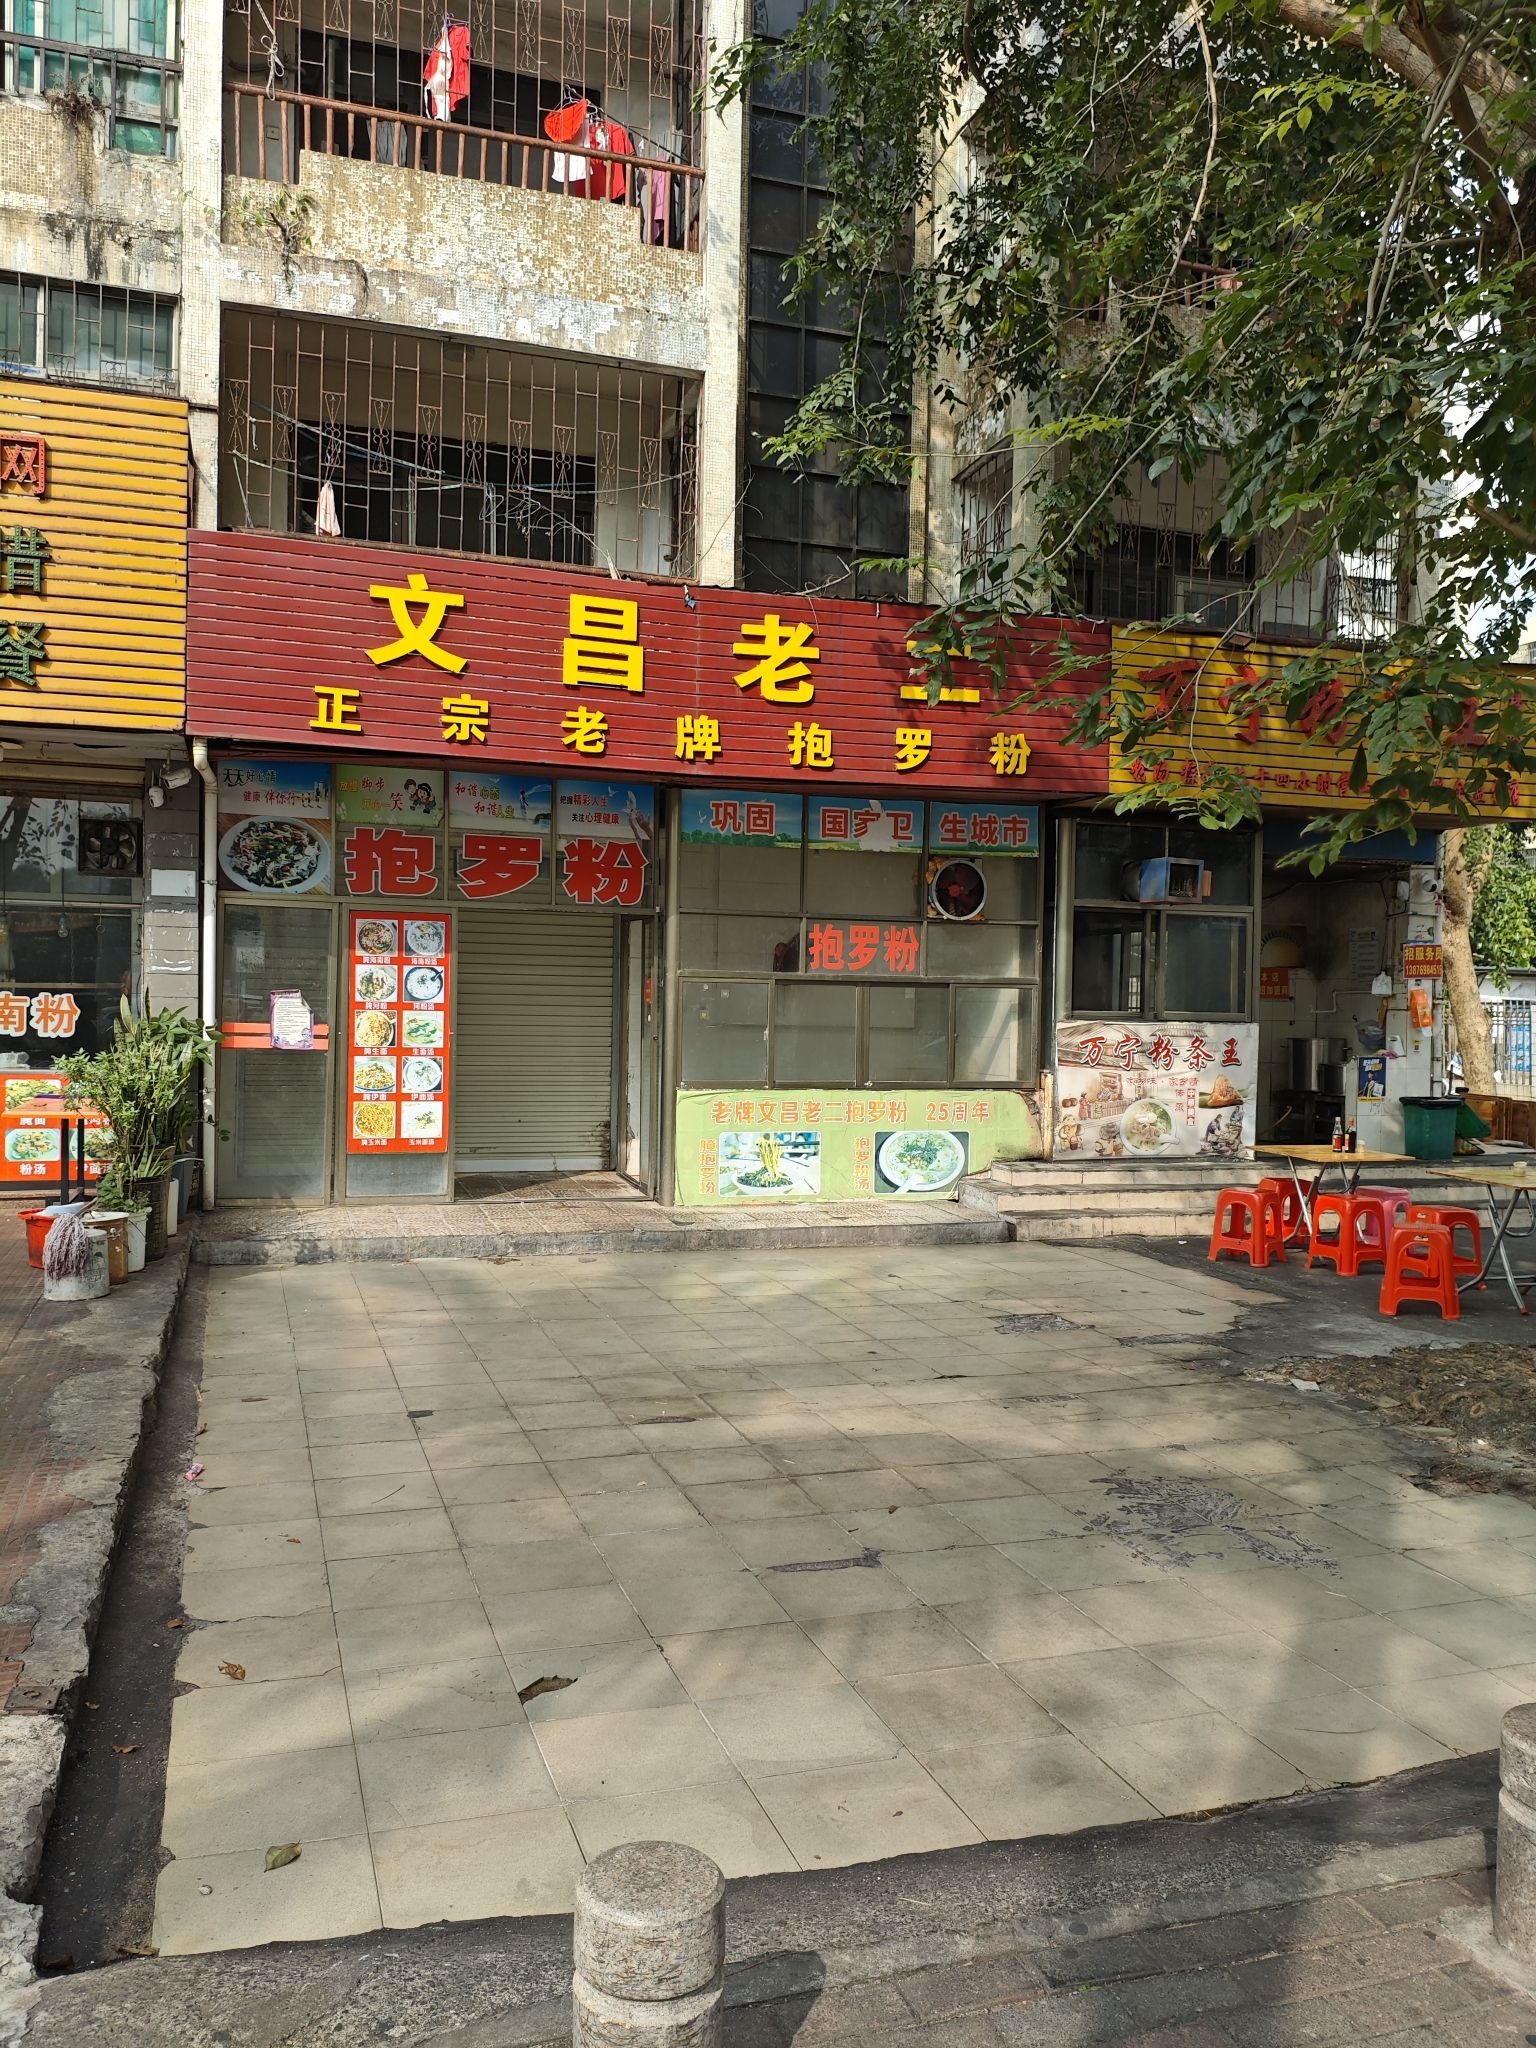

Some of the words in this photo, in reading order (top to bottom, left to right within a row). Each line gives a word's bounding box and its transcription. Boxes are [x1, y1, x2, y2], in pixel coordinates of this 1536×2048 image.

[364, 573, 980, 704] 文昌老二
[309, 685, 1031, 775] 正宗老牌抱罗粉
[223, 767, 277, 787] 天天好心情
[455, 782, 500, 801] 和谐心态
[474, 801, 515, 819] 和谐人生
[559, 793, 608, 807] 把握精彩人生
[571, 812, 620, 825] 关注心理健康
[710, 800, 776, 836] 巩固
[939, 811, 1030, 847] 生城市
[344, 826, 650, 906] 抱罗粉
[808, 923, 920, 972] 抱罗粉
[0, 992, 81, 1038] 南粉
[1078, 1032, 1242, 1071] 万宁粉条王
[711, 1099, 908, 1125] 老牌文昌老二抱罗粉
[926, 1101, 990, 1124] 25周年
[19, 1163, 46, 1175] 粉汤
[699, 1139, 717, 1194] 腌抱罗粉
[853, 1137, 871, 1191] 抱罗粉汤
